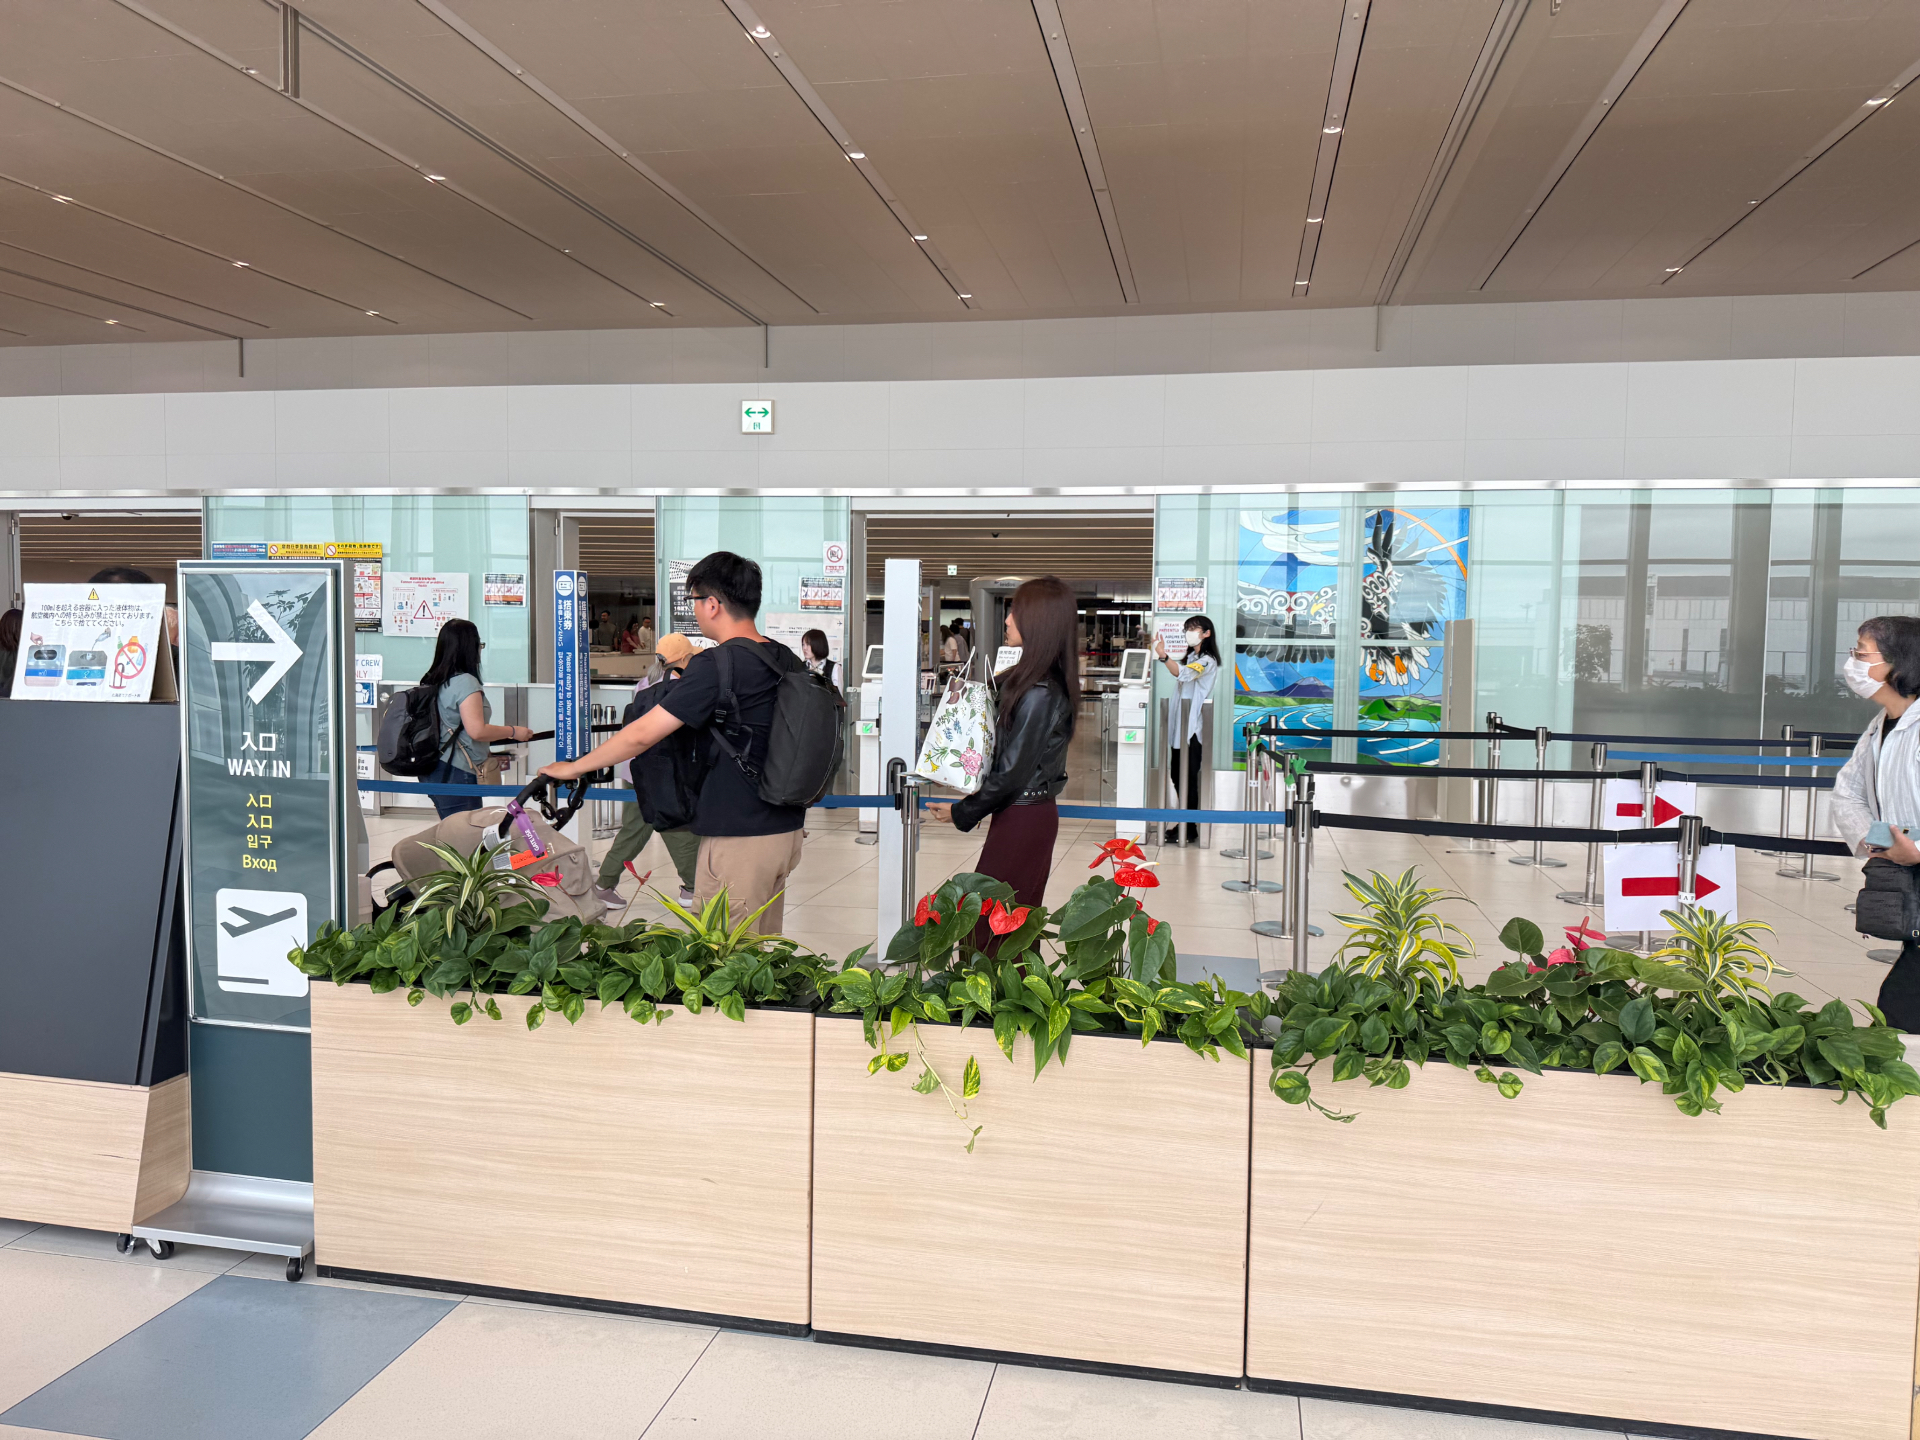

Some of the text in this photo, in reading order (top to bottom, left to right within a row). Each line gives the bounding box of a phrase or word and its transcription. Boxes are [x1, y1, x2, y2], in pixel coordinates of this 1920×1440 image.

[361, 659, 381, 667] CREW
[565, 651, 573, 672] Please
[565, 673, 573, 691] ready
[240, 731, 276, 751] 入口
[565, 732, 573, 759] boarding
[227, 758, 291, 778] WAY IN
[246, 793, 272, 808] 入口
[246, 814, 273, 829] 入口
[247, 834, 273, 849] 입구
[242, 854, 278, 872] Вход
